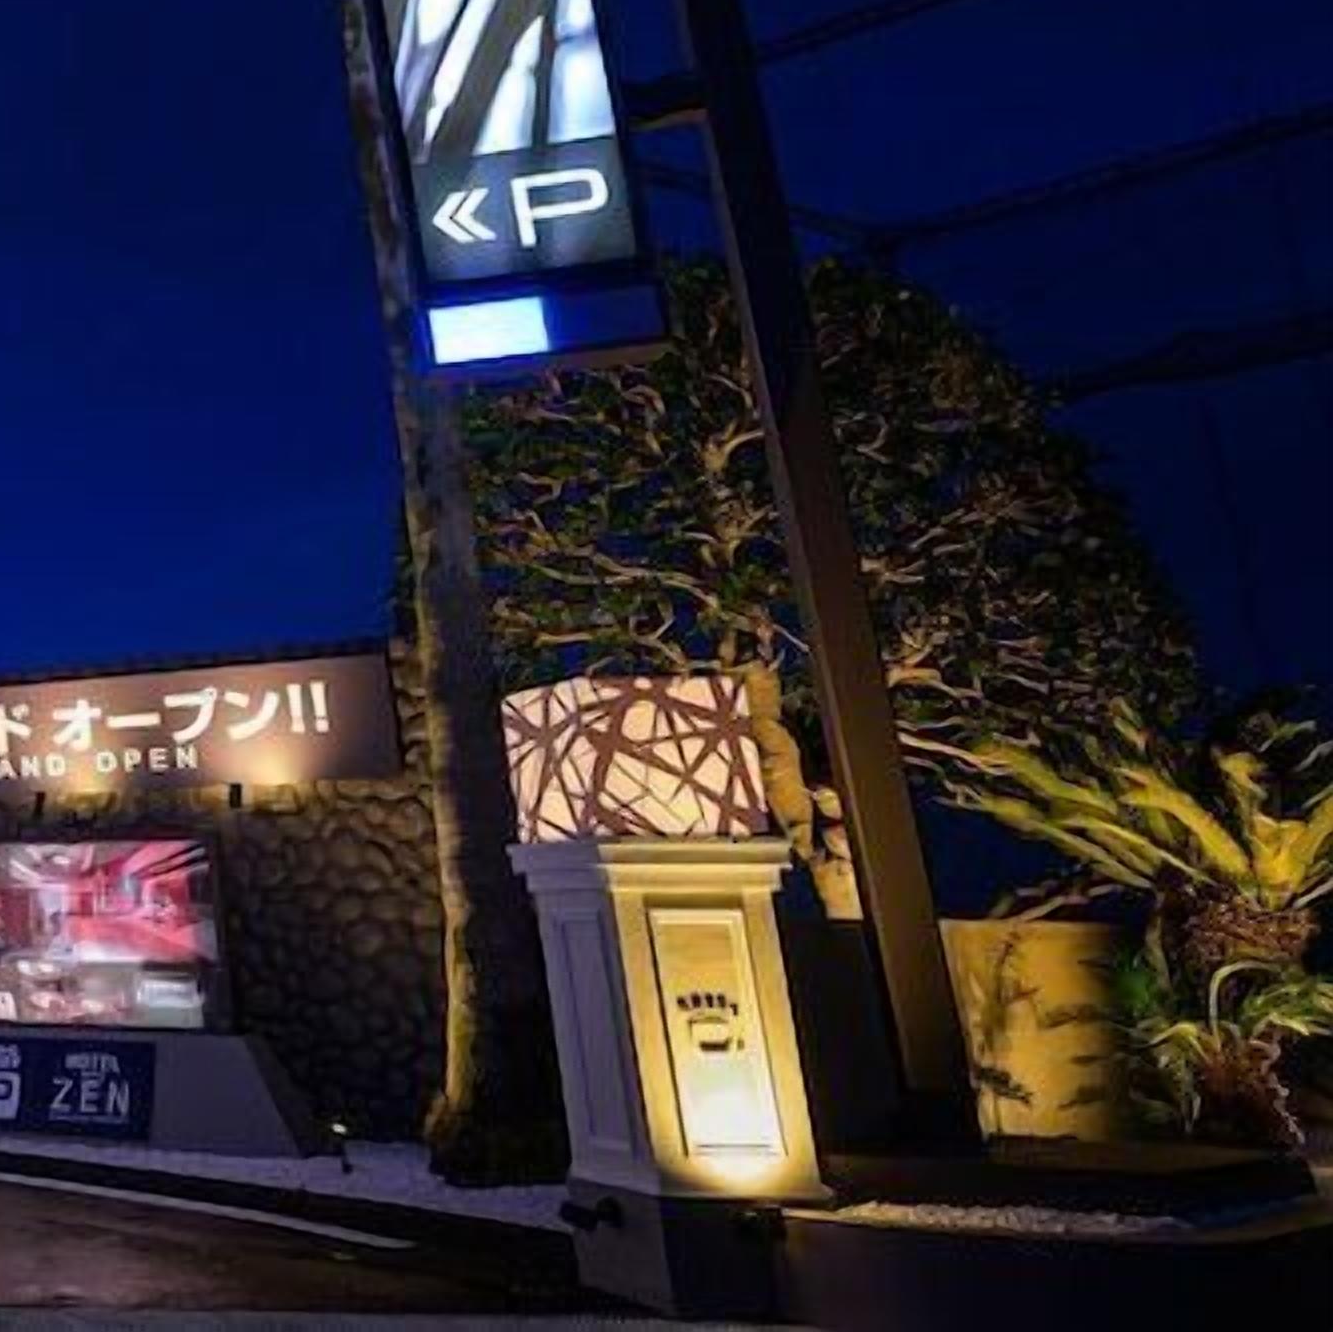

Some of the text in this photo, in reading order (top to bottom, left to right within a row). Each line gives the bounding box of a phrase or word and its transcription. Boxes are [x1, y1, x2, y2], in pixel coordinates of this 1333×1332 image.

[511, 168, 609, 248] P
[96, 745, 200, 773] OPEN
[49, 1075, 130, 1116] ZEN
